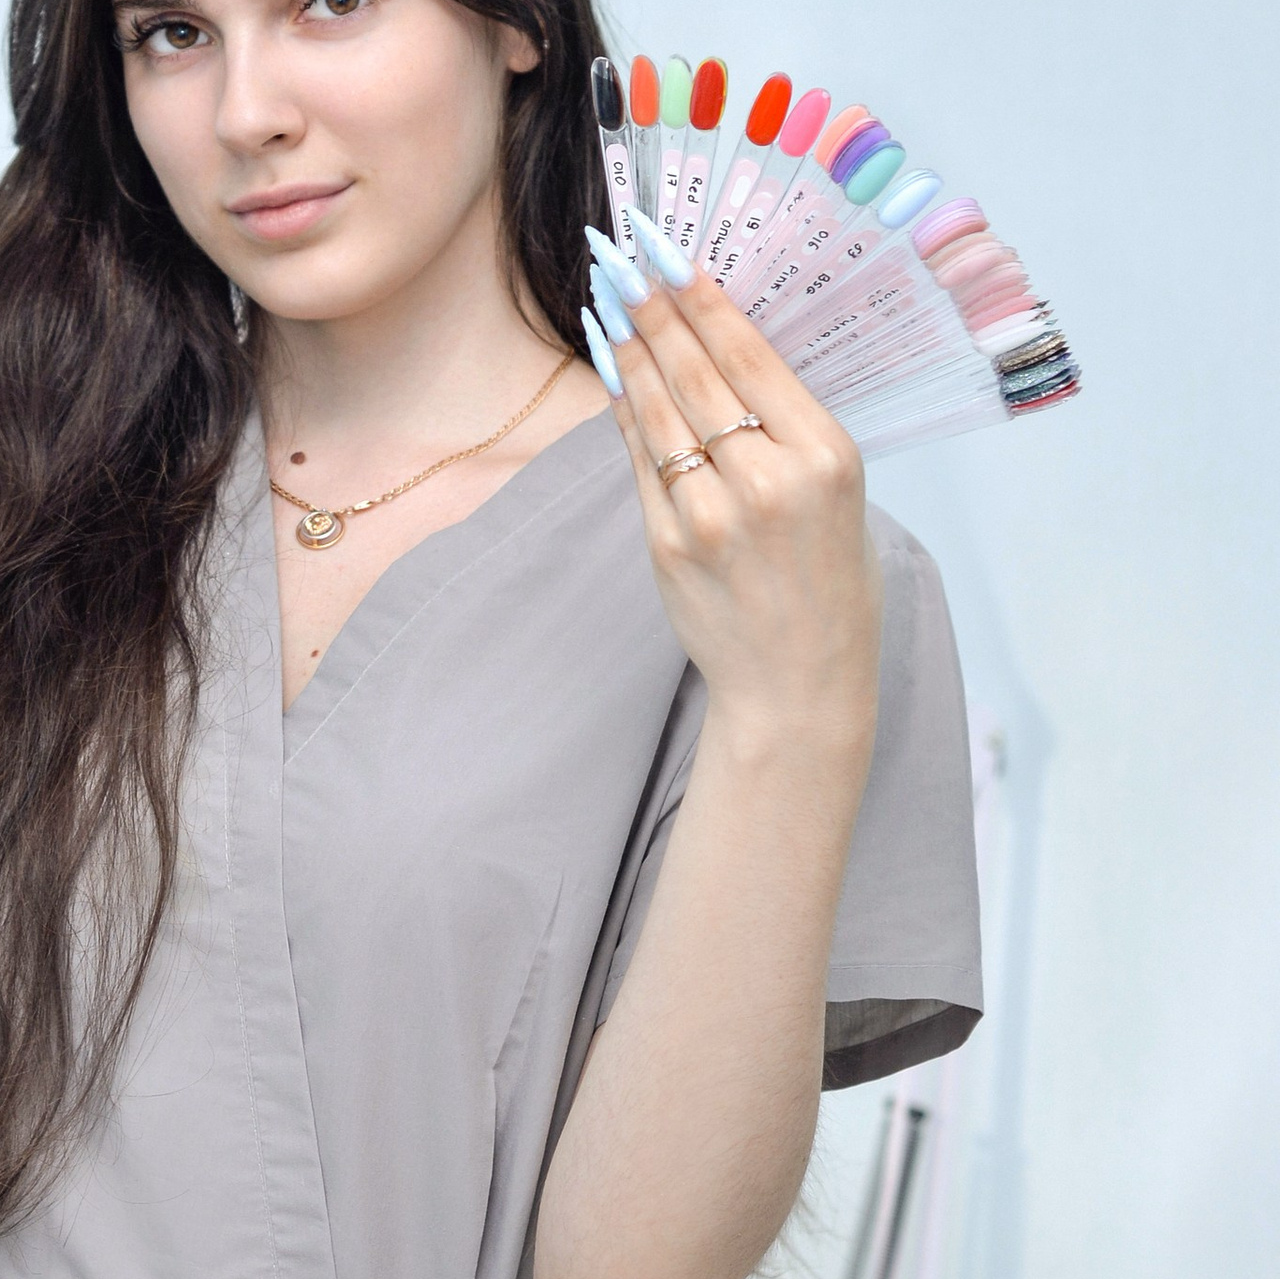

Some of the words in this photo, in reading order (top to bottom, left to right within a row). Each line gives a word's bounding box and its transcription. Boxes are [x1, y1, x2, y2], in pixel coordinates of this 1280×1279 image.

[687, 176, 703, 204] Red
[808, 230, 829, 250] 016
[770, 264, 799, 291] Pink
[805, 273, 831, 295] BSG
